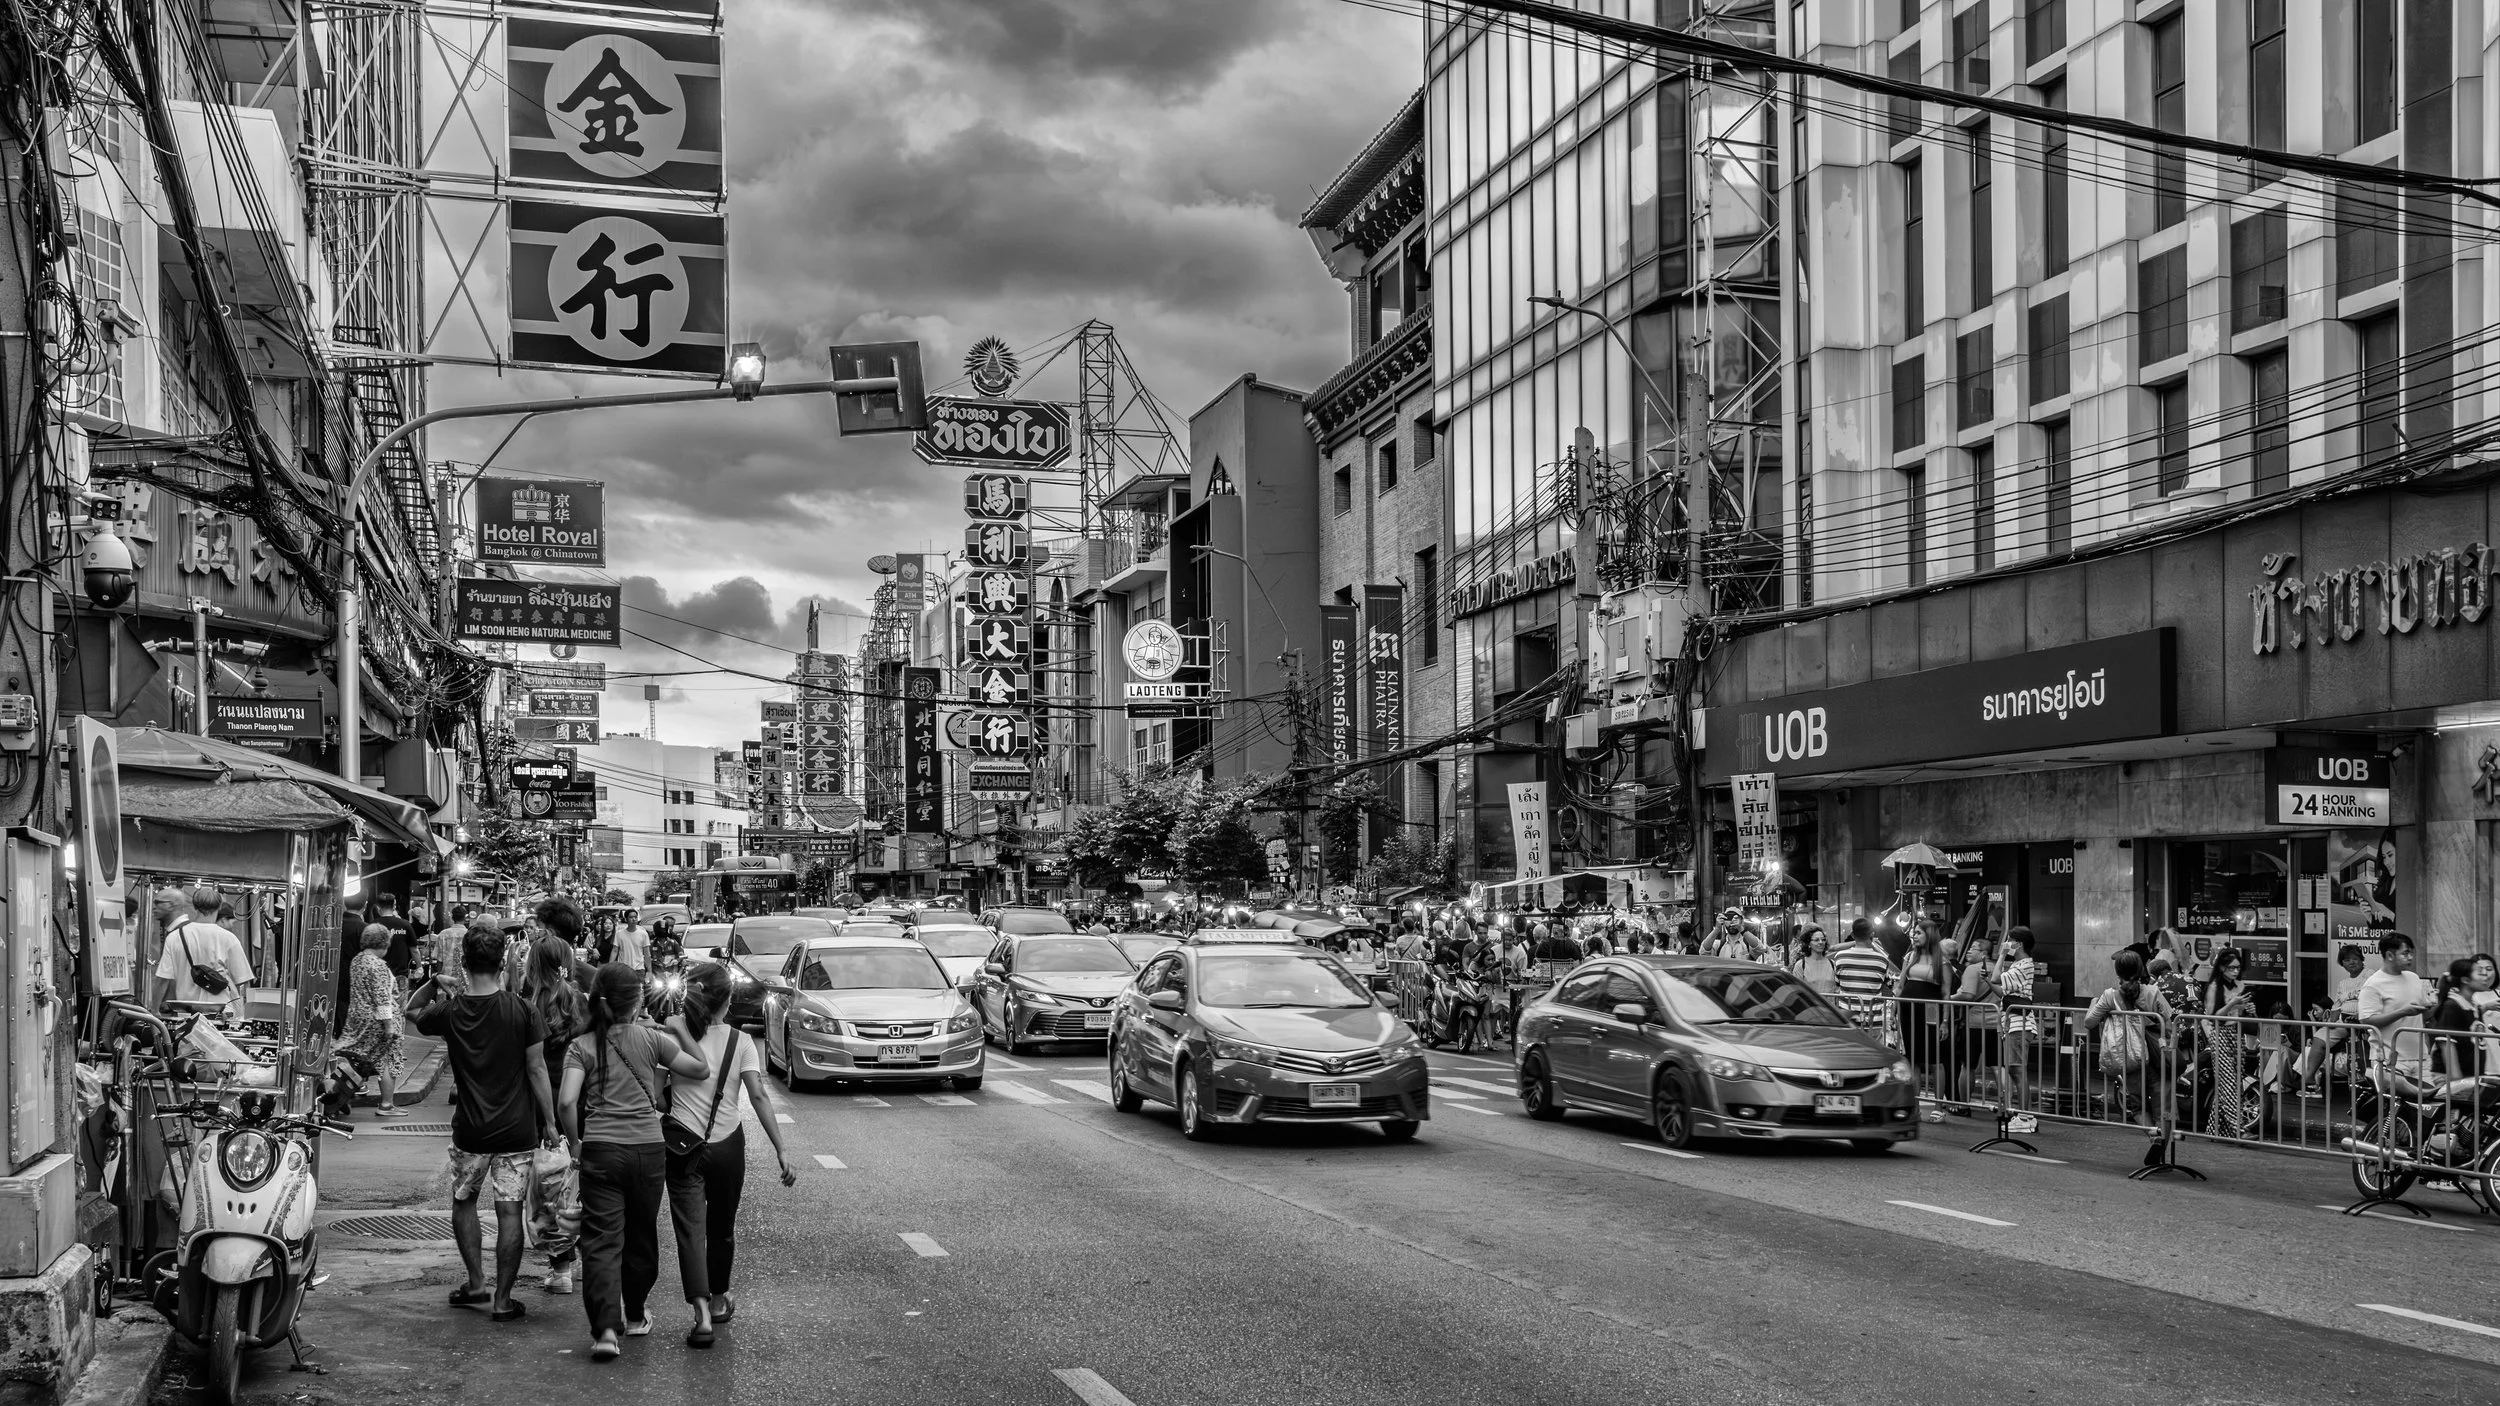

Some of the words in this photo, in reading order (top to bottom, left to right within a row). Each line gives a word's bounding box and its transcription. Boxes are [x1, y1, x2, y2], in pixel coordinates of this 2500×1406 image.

[557, 47, 674, 348] 金行
[937, 401, 999, 422] ห้างทอง
[932, 410, 1056, 456] ทองใบ
[483, 523, 535, 542] Hotel
[542, 526, 597, 546] Royal
[485, 545, 528, 558] Bangkok
[531, 547, 542, 559] @
[544, 547, 598, 560] Chinatown
[466, 589, 523, 604] ร้านขายยา
[1450, 579, 1487, 618] GOLD
[1489, 558, 1542, 604] TRADE
[2248, 543, 2500, 655] ห้างขายทอ
[464, 624, 479, 634] LIM
[481, 625, 505, 636] SOON
[506, 626, 530, 637] HENG
[531, 627, 569, 639] NATURAL
[570, 628, 612, 640] MEDICINE
[1129, 685, 1182, 696] LAOTENG
[1982, 668, 2106, 721] ธนาคารยูโอบี
[1375, 670, 1386, 729] PHATRA
[1387, 670, 1399, 752] KIATNAKIN
[226, 721, 253, 730] Thanon
[254, 722, 277, 732] Plaeng
[278, 723, 294, 731] Nam
[1765, 706, 1828, 763] UOB
[914, 706, 933, 822] 北京同仁堂
[2317, 757, 2369, 781] UOB
[970, 774, 1030, 787] EXCHANGE
[2291, 792, 2319, 816] 24
[2322, 793, 2357, 806] HOUR
[2322, 805, 2376, 818] BANKING
[1520, 810, 1541, 821] เกา
[1523, 825, 1541, 840] ลัด
[1952, 851, 1983, 864] BANKING
[2049, 857, 2074, 874] UOB
[767, 878, 778, 888] 40
[2337, 923, 2347, 937] ให้
[2348, 926, 2369, 938] SME
[895, 1045, 915, 1055] 8767
